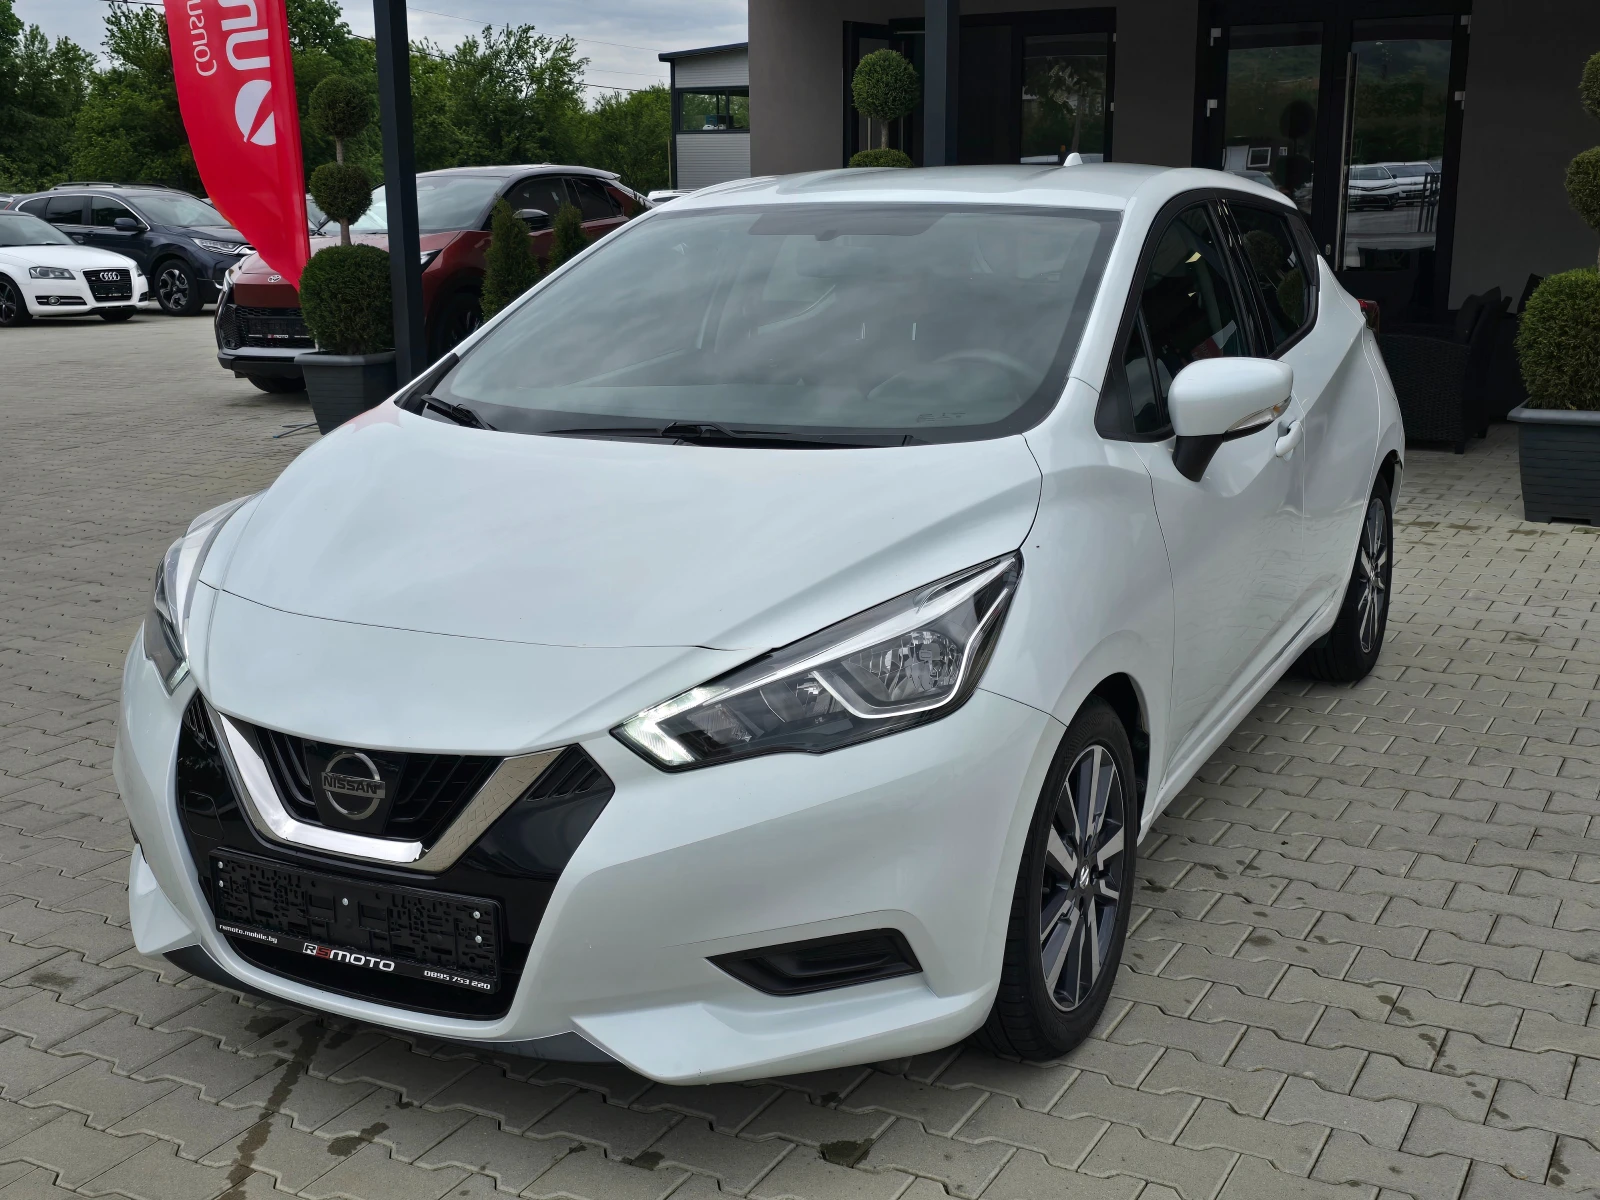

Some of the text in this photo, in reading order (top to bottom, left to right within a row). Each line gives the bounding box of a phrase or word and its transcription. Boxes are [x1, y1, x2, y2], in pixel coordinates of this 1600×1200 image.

[323, 774, 378, 795] NISSAN
[219, 924, 278, 944] rsmoto.mobile.bg
[303, 942, 396, 972] RSMOTO
[423, 970, 491, 990] 0895 753 220
